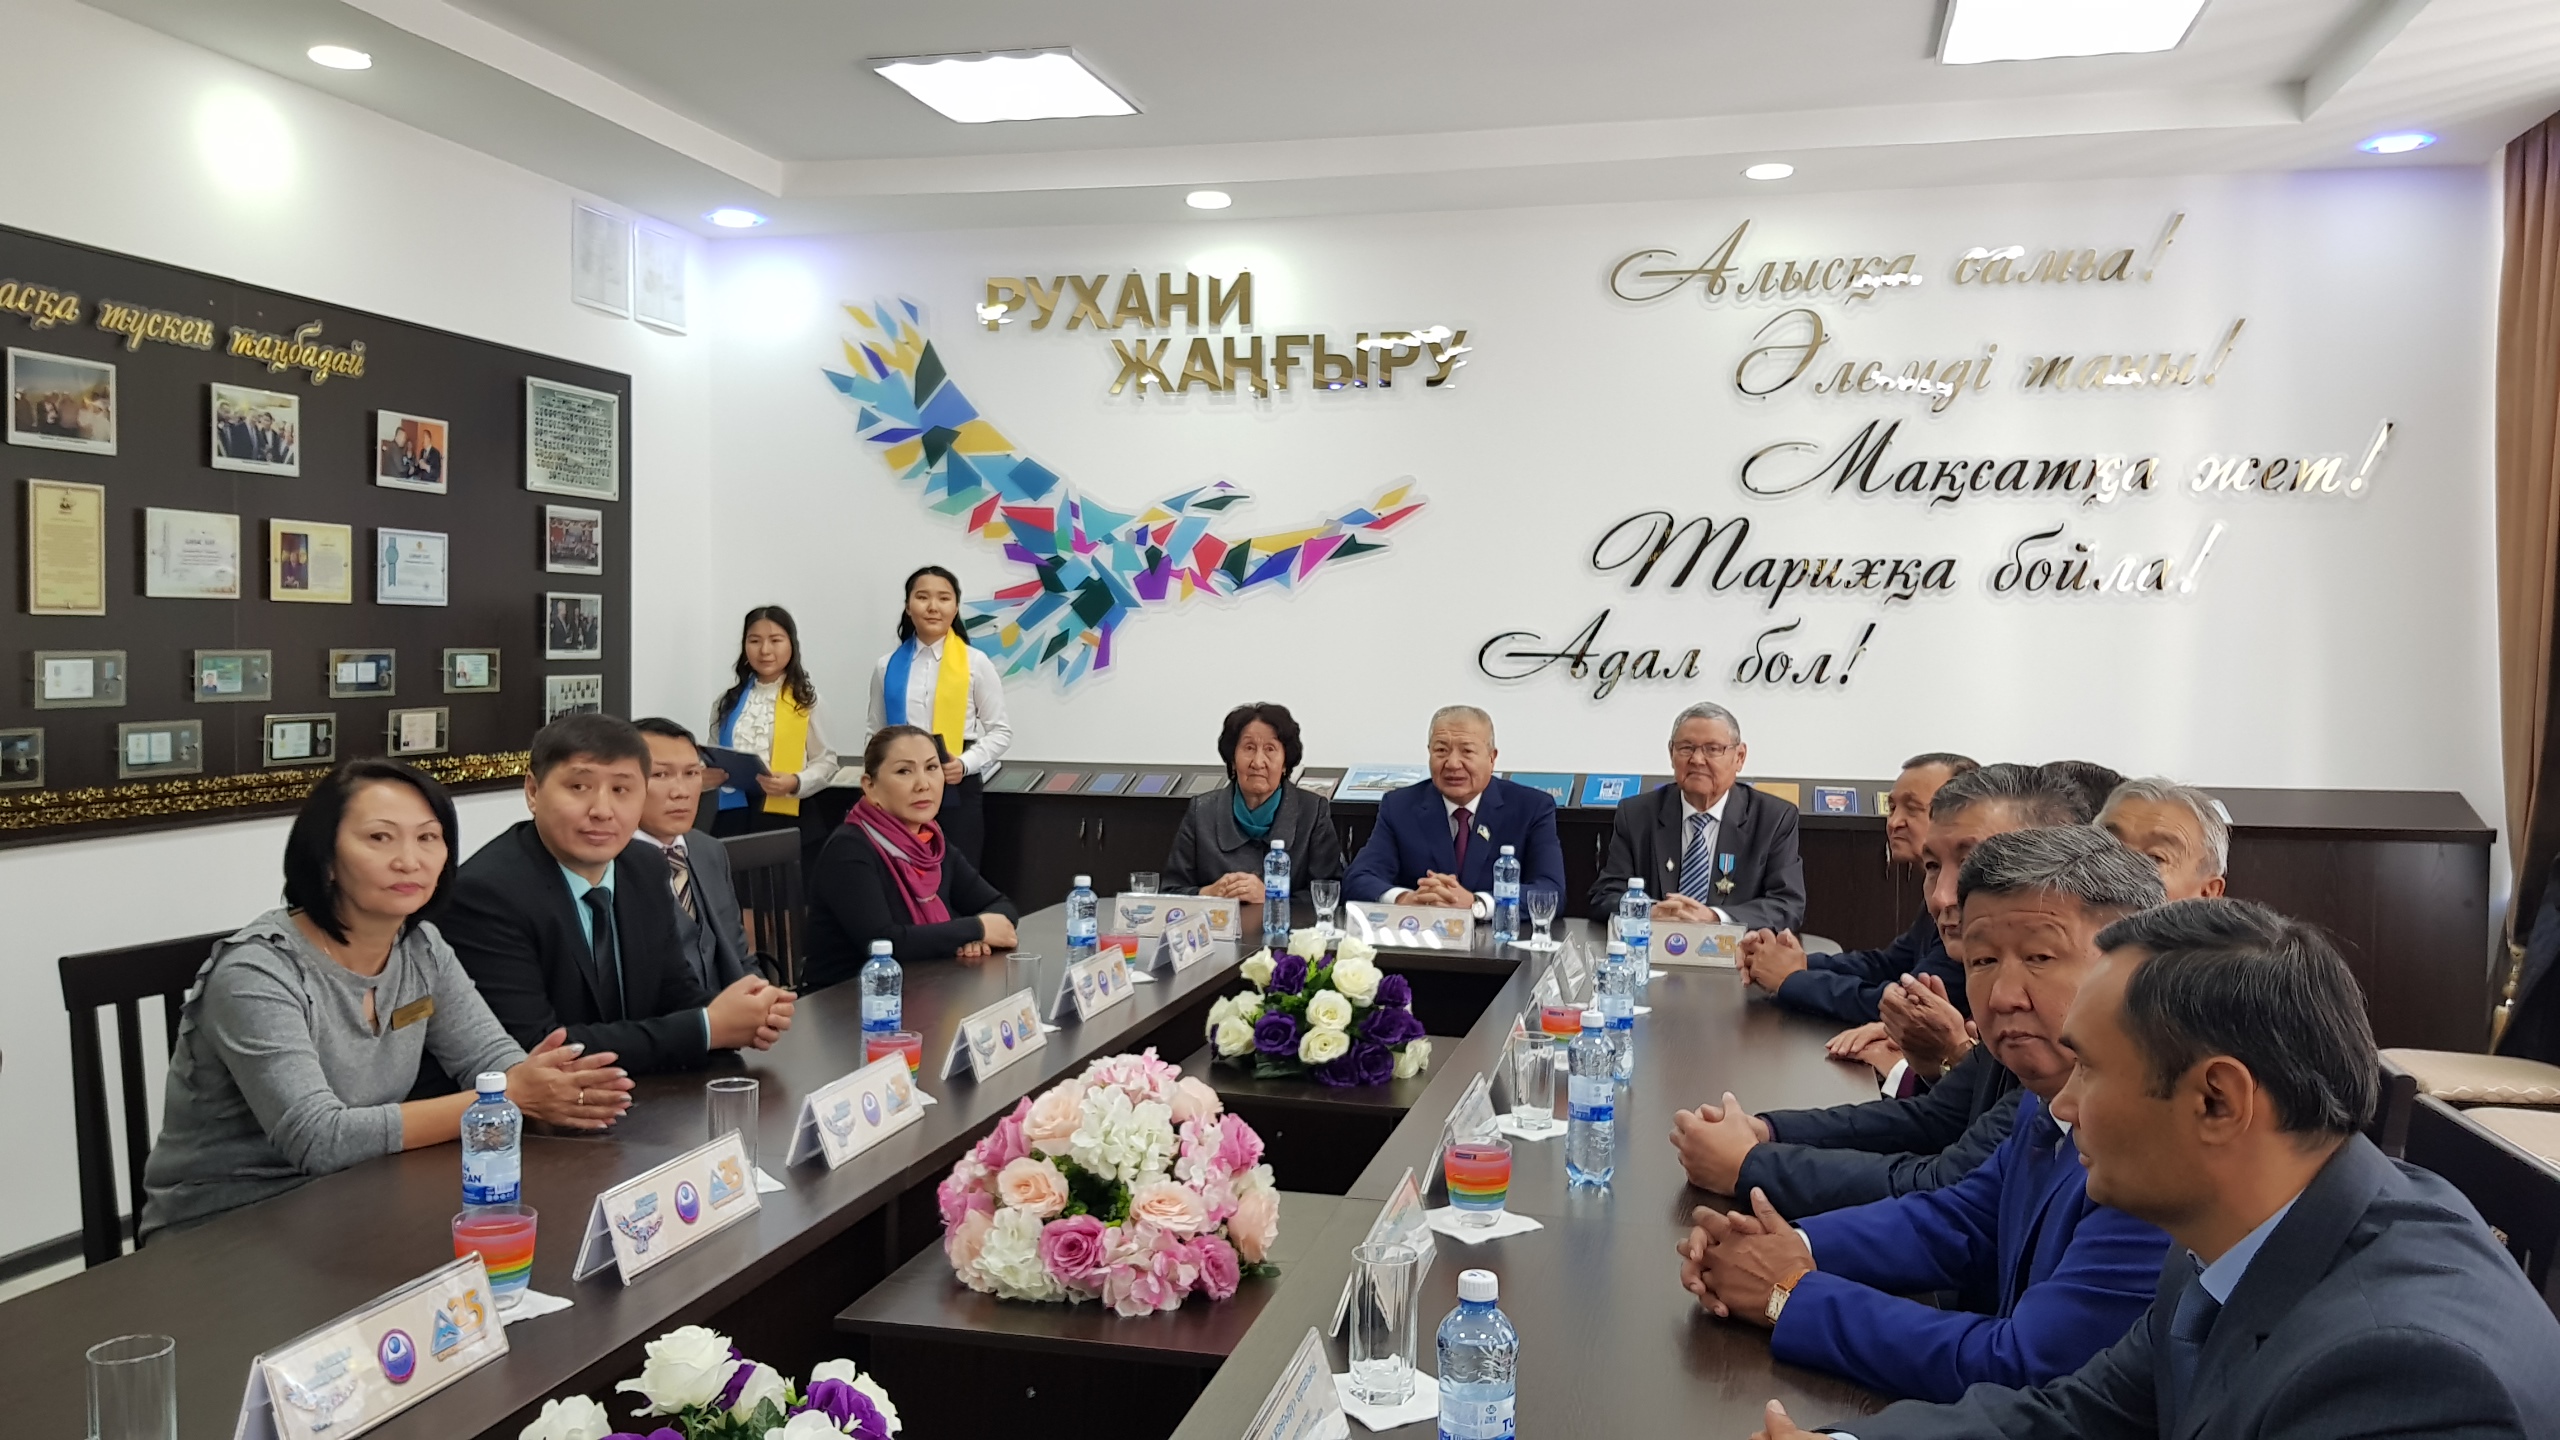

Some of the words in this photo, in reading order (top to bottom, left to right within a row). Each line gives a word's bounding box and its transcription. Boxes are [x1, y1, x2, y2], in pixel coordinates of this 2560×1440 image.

[984, 271, 1252, 332] РУХАНИ
[231, 324, 365, 382] таңбадай
[1108, 330, 1470, 399] ЖАҢҒЫРУ
[1741, 417, 2159, 508] Мақсатқа
[2191, 422, 2394, 493] жет!
[1993, 521, 2224, 594] бойла!
[1478, 608, 1700, 700] Адал
[1734, 616, 1877, 686] бол!
